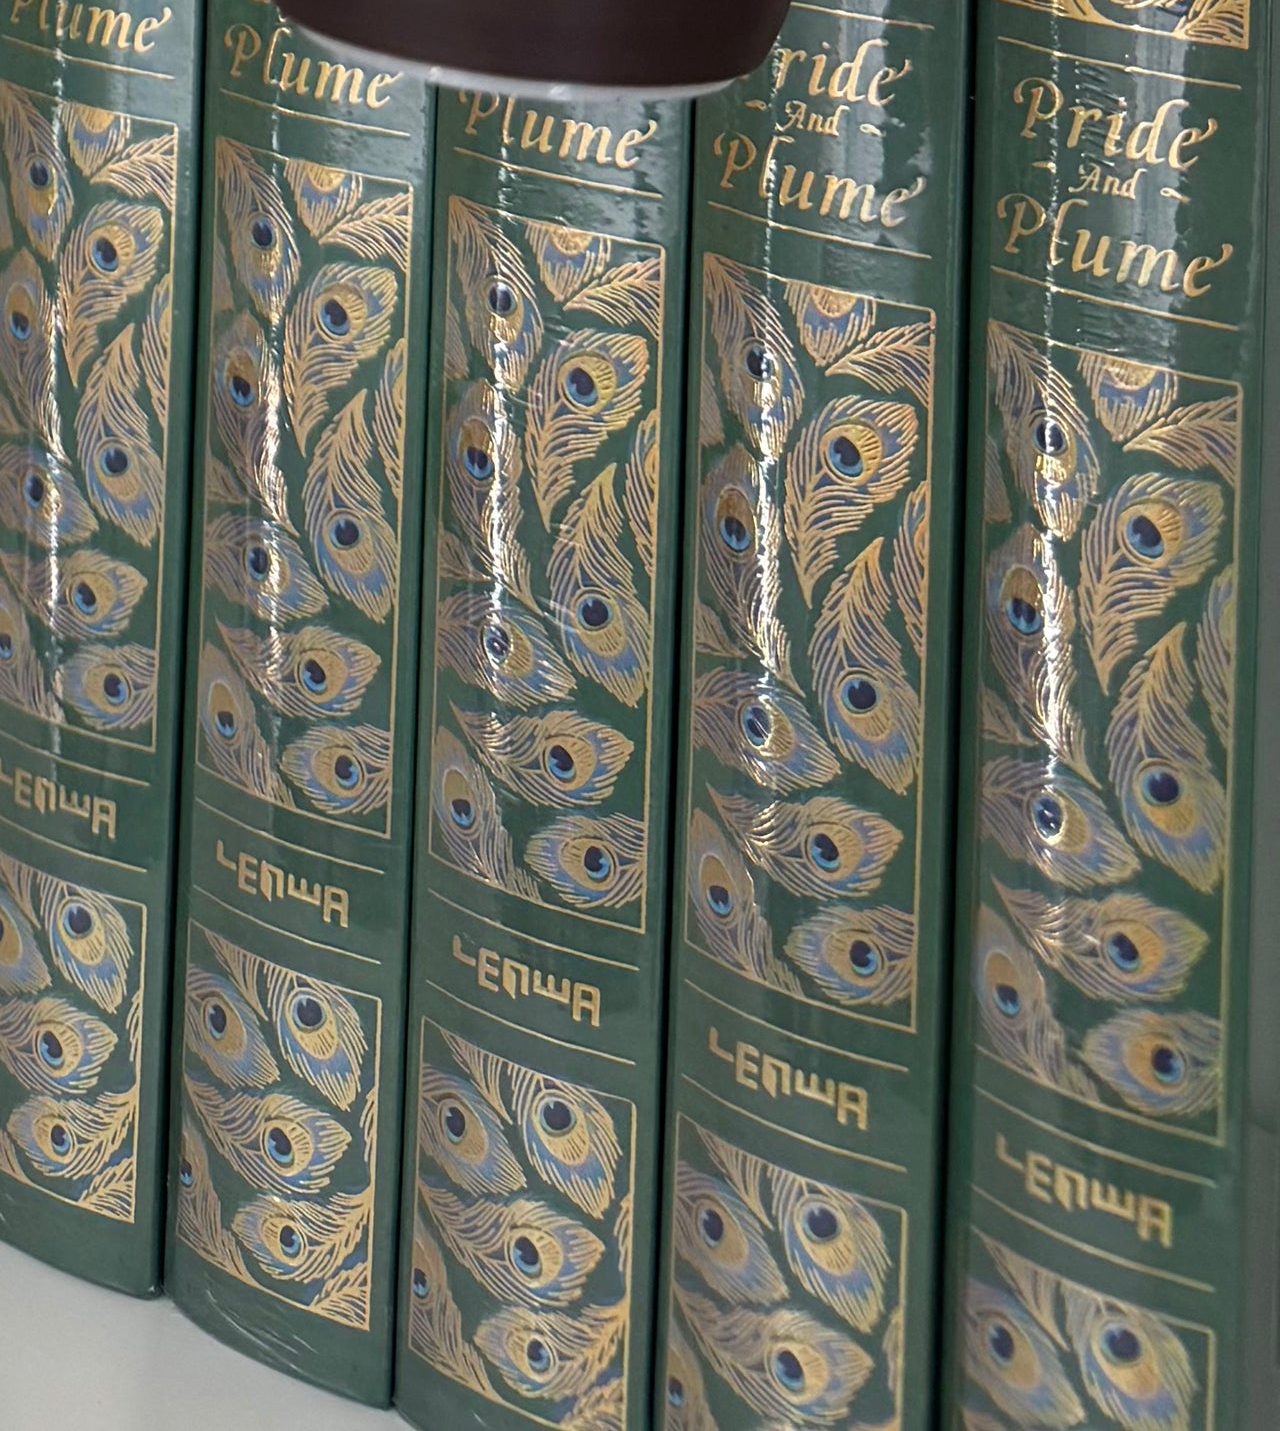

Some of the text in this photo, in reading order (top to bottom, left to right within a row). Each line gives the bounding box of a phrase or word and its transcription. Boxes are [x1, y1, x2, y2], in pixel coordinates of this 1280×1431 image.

[224, 23, 404, 110] Plume
[774, 38, 912, 106] ride
[458, 89, 657, 170] Plume
[775, 99, 849, 137] And
[1013, 76, 1218, 171] Pride
[713, 132, 926, 228] Plume
[1068, 163, 1145, 201] And
[997, 193, 1233, 299] Plume
